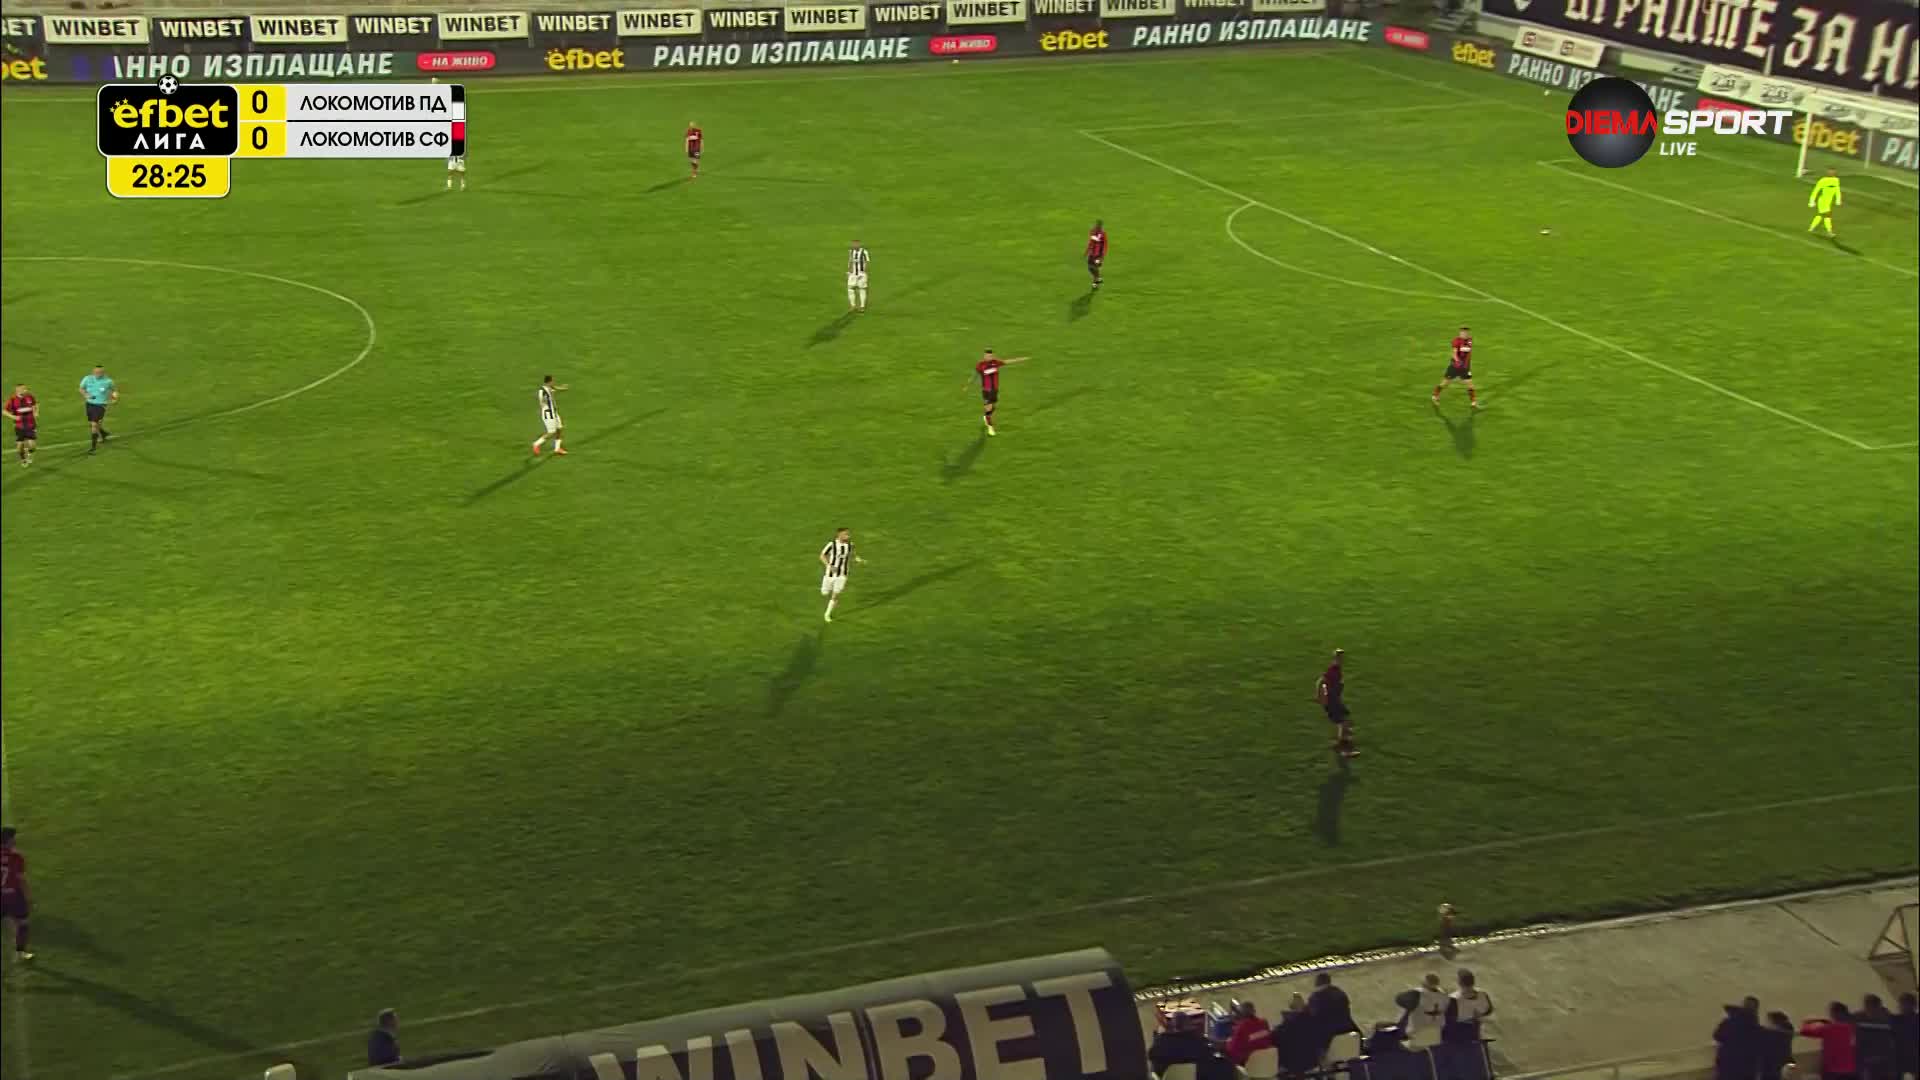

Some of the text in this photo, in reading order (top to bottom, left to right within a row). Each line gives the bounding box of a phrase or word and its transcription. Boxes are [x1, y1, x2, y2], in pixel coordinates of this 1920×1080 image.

[875, 5, 941, 22] WINBET
[954, 1, 1021, 18] WINBET
[1034, 0, 1097, 14] WINBET
[445, 16, 521, 32] WINBET
[538, 15, 611, 32] WINBET
[624, 13, 695, 29] WINBET
[709, 11, 779, 28] WINBET
[792, 8, 860, 25] WINBET
[53, 19, 139, 36] WINBET
[160, 19, 244, 38] WINBET
[258, 19, 340, 36] WINBET
[355, 17, 432, 35] WINBET
[1133, 24, 1211, 46] РАННО
[1219, 18, 1372, 42] ИЗПЛАЩАНЕ
[1040, 31, 1109, 51] efbet
[1783, 8, 1856, 75] ЗА
[547, 48, 625, 70] efbet
[653, 37, 911, 67] РАННО ИЗПЛАЩАНЕ
[1452, 42, 1496, 69] efbet
[204, 52, 394, 77] ИЗПЛАЩАНЕ
[1508, 54, 1563, 86] РАННО
